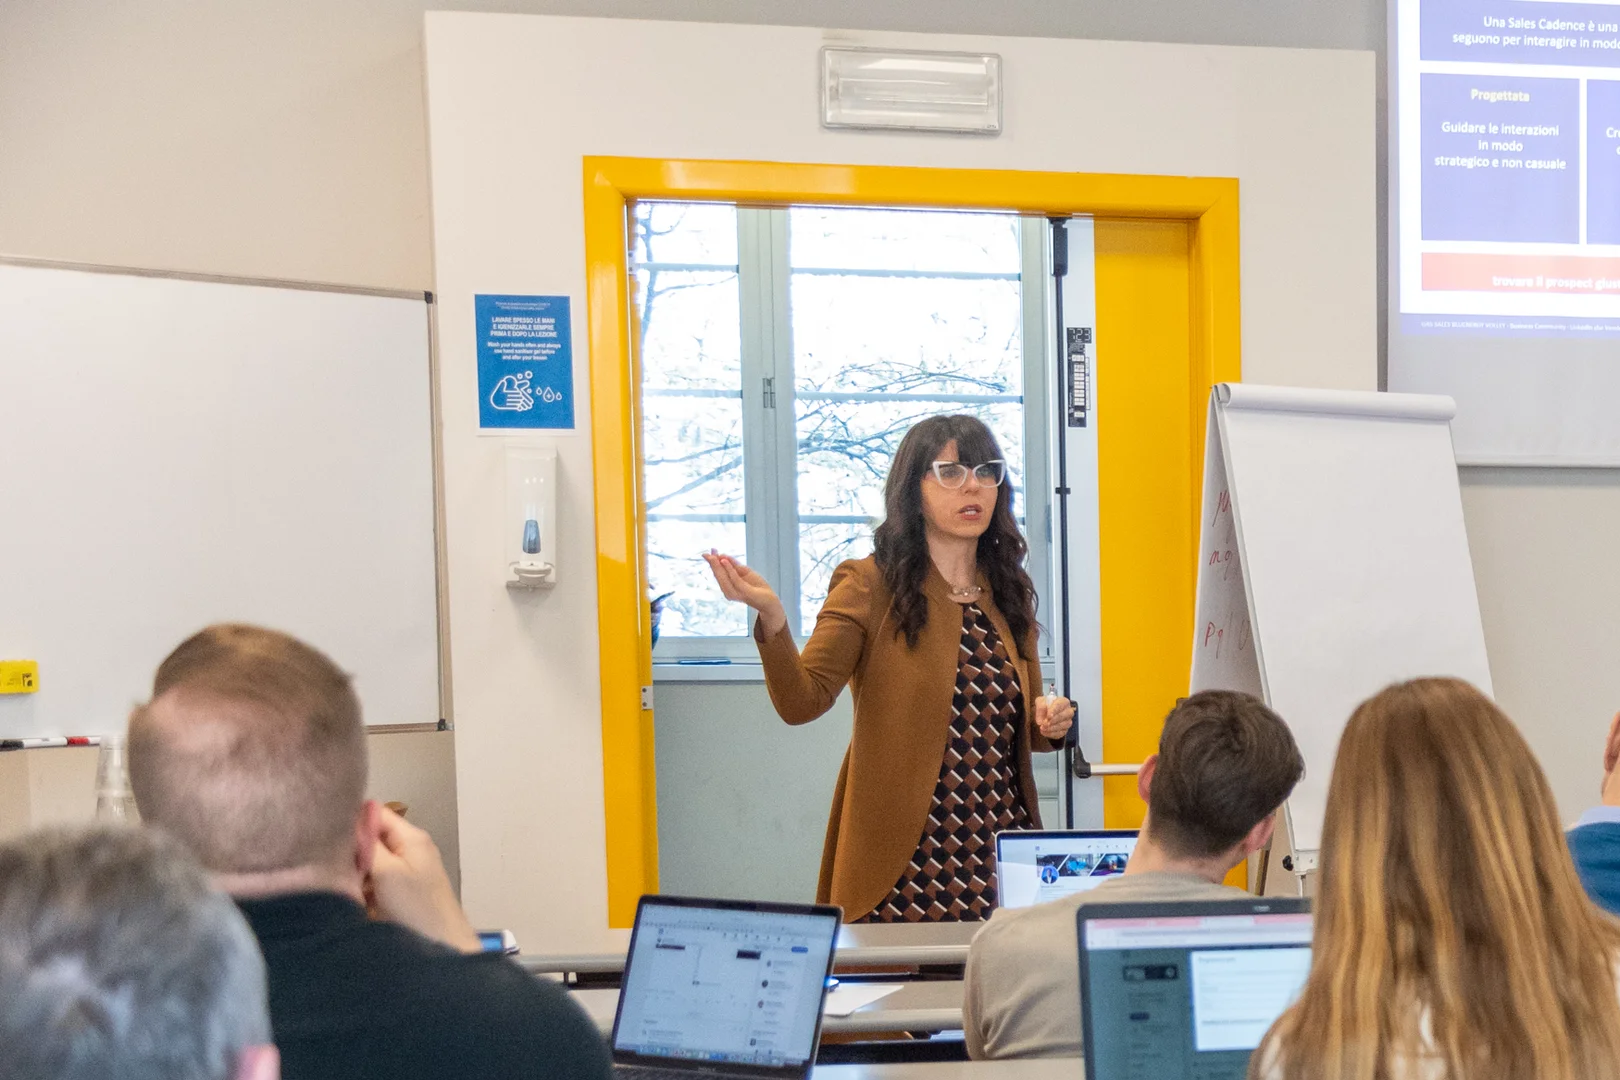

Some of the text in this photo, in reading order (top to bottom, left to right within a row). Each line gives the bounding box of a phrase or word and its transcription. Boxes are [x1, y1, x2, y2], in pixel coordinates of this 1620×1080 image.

[1484, 16, 1505, 28] Una
[1508, 17, 1536, 29] Sales
[1539, 18, 1585, 31] Cadence
[1598, 24, 1618, 33] una
[1452, 34, 1500, 46] seguono
[1503, 36, 1521, 47] per
[1524, 33, 1577, 49] interagire
[1580, 36, 1590, 48] in
[1471, 88, 1530, 102] Progettata
[1441, 122, 1559, 136] Guidare le interazioni
[1478, 140, 1523, 151] in modo
[1434, 156, 1566, 169] strategico e non casuale
[1493, 276, 1533, 287] trovare
[1536, 277, 1543, 287] il
[1546, 277, 1593, 290] prospect
